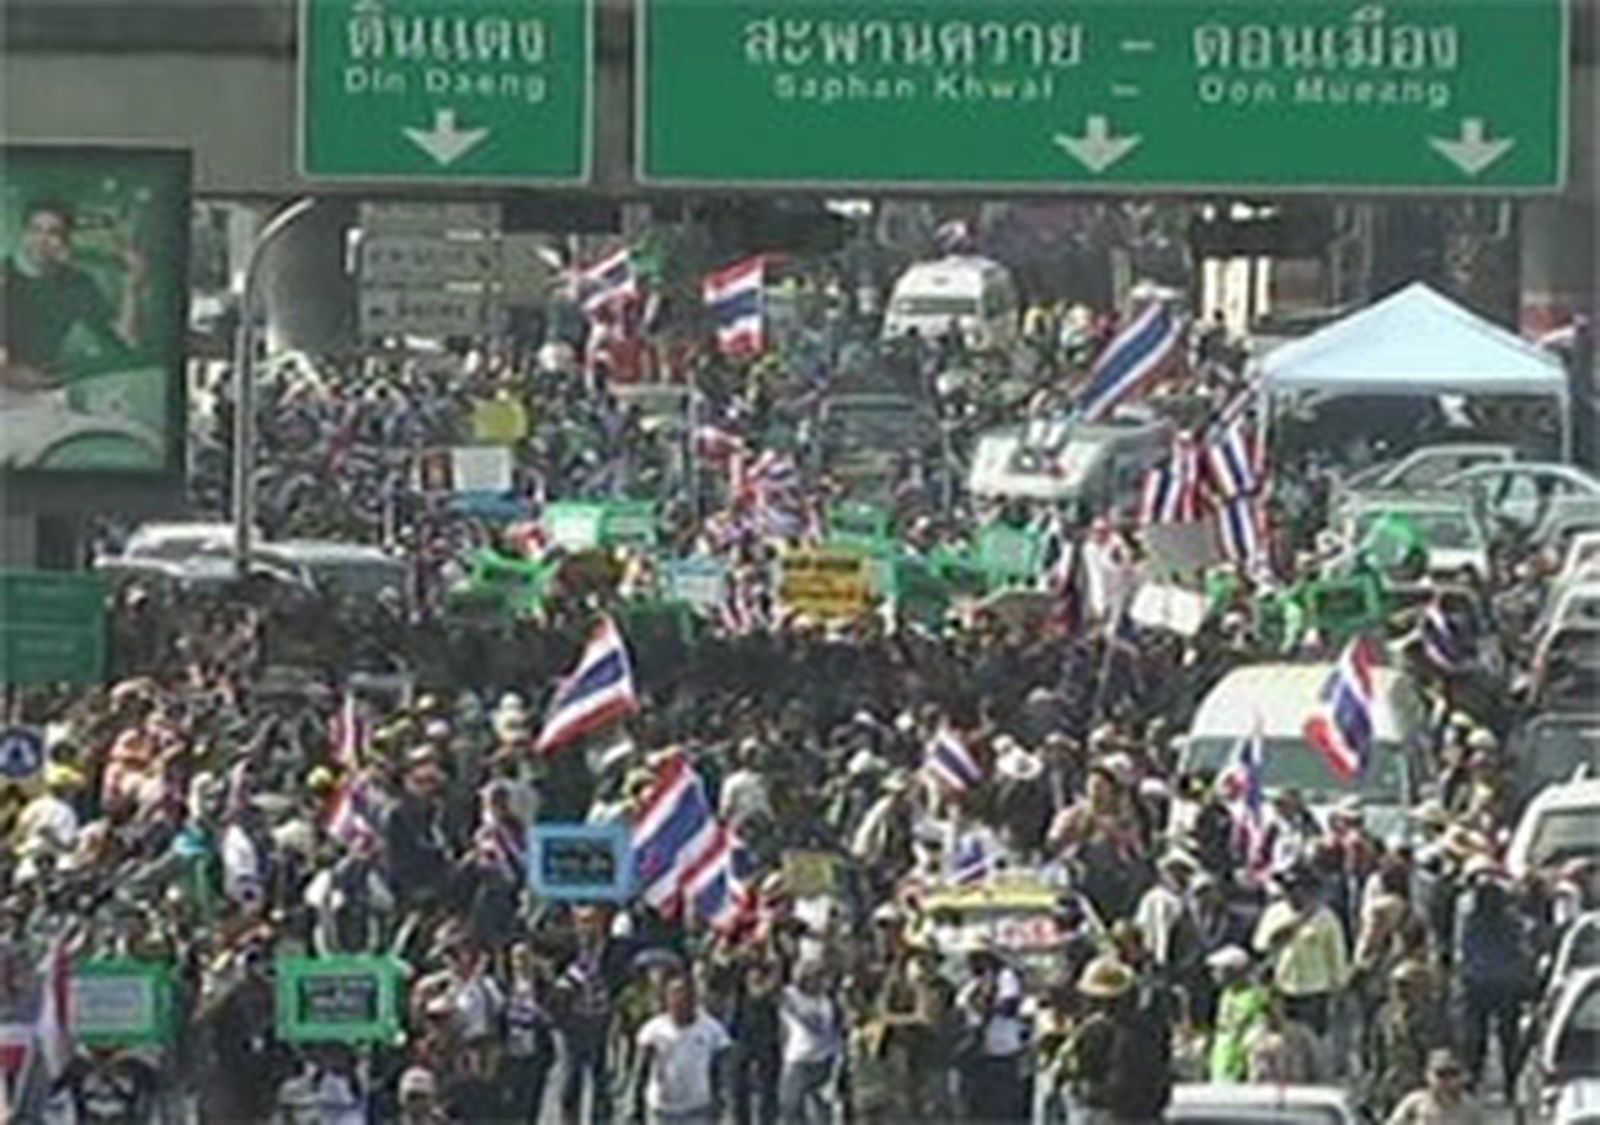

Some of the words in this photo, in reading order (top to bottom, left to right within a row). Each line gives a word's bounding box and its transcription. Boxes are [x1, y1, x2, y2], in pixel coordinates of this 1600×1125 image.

[744, 16, 1084, 66] สะพานควาย
[1193, 4, 1459, 70] ดอนเมือง
[424, 66, 547, 103] Daeng
[773, 73, 915, 101] Saphan
